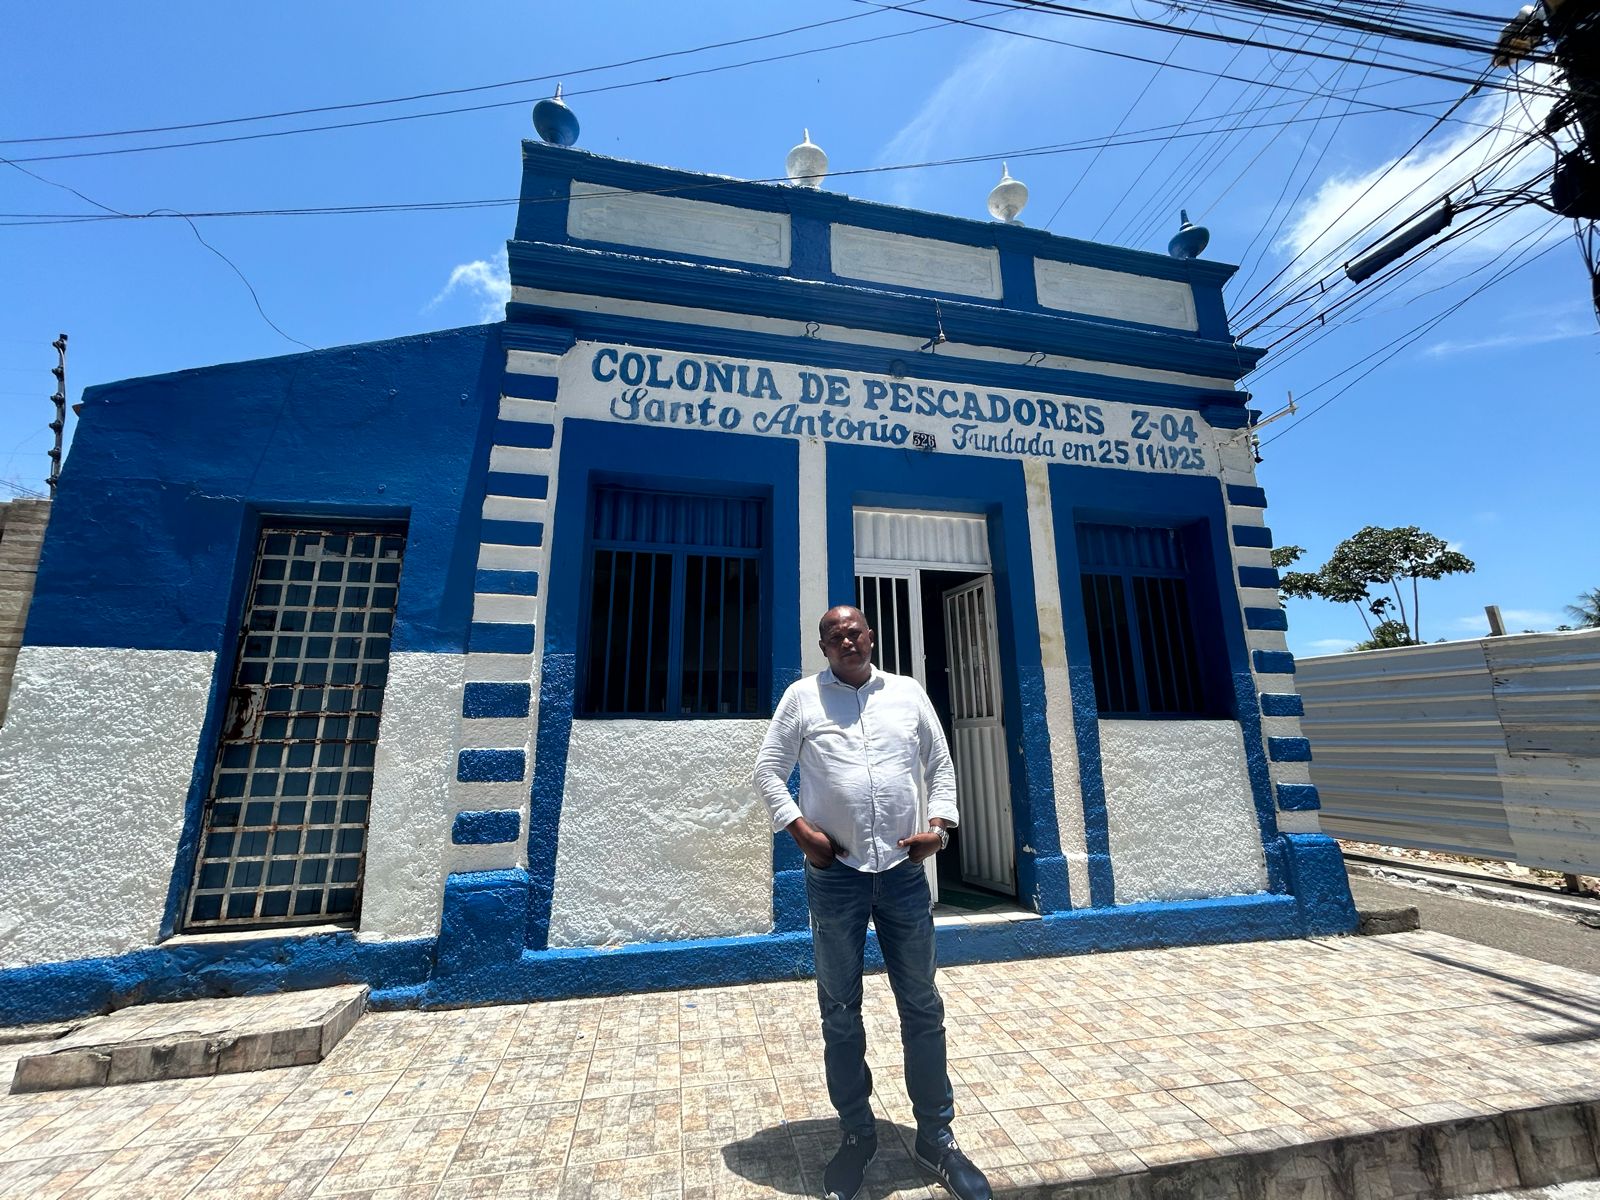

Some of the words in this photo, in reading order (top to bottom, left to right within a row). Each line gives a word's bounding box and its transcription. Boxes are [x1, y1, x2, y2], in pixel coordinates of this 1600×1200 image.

[592, 348, 782, 400] COLONIA
[799, 371, 850, 407] DE
[863, 379, 1105, 435] PESCADORES
[1131, 410, 1198, 444] Z-04
[610, 387, 741, 430] Santo
[913, 432, 936, 449] 326
[951, 423, 1056, 457] Fundada
[1062, 442, 1097, 462] em
